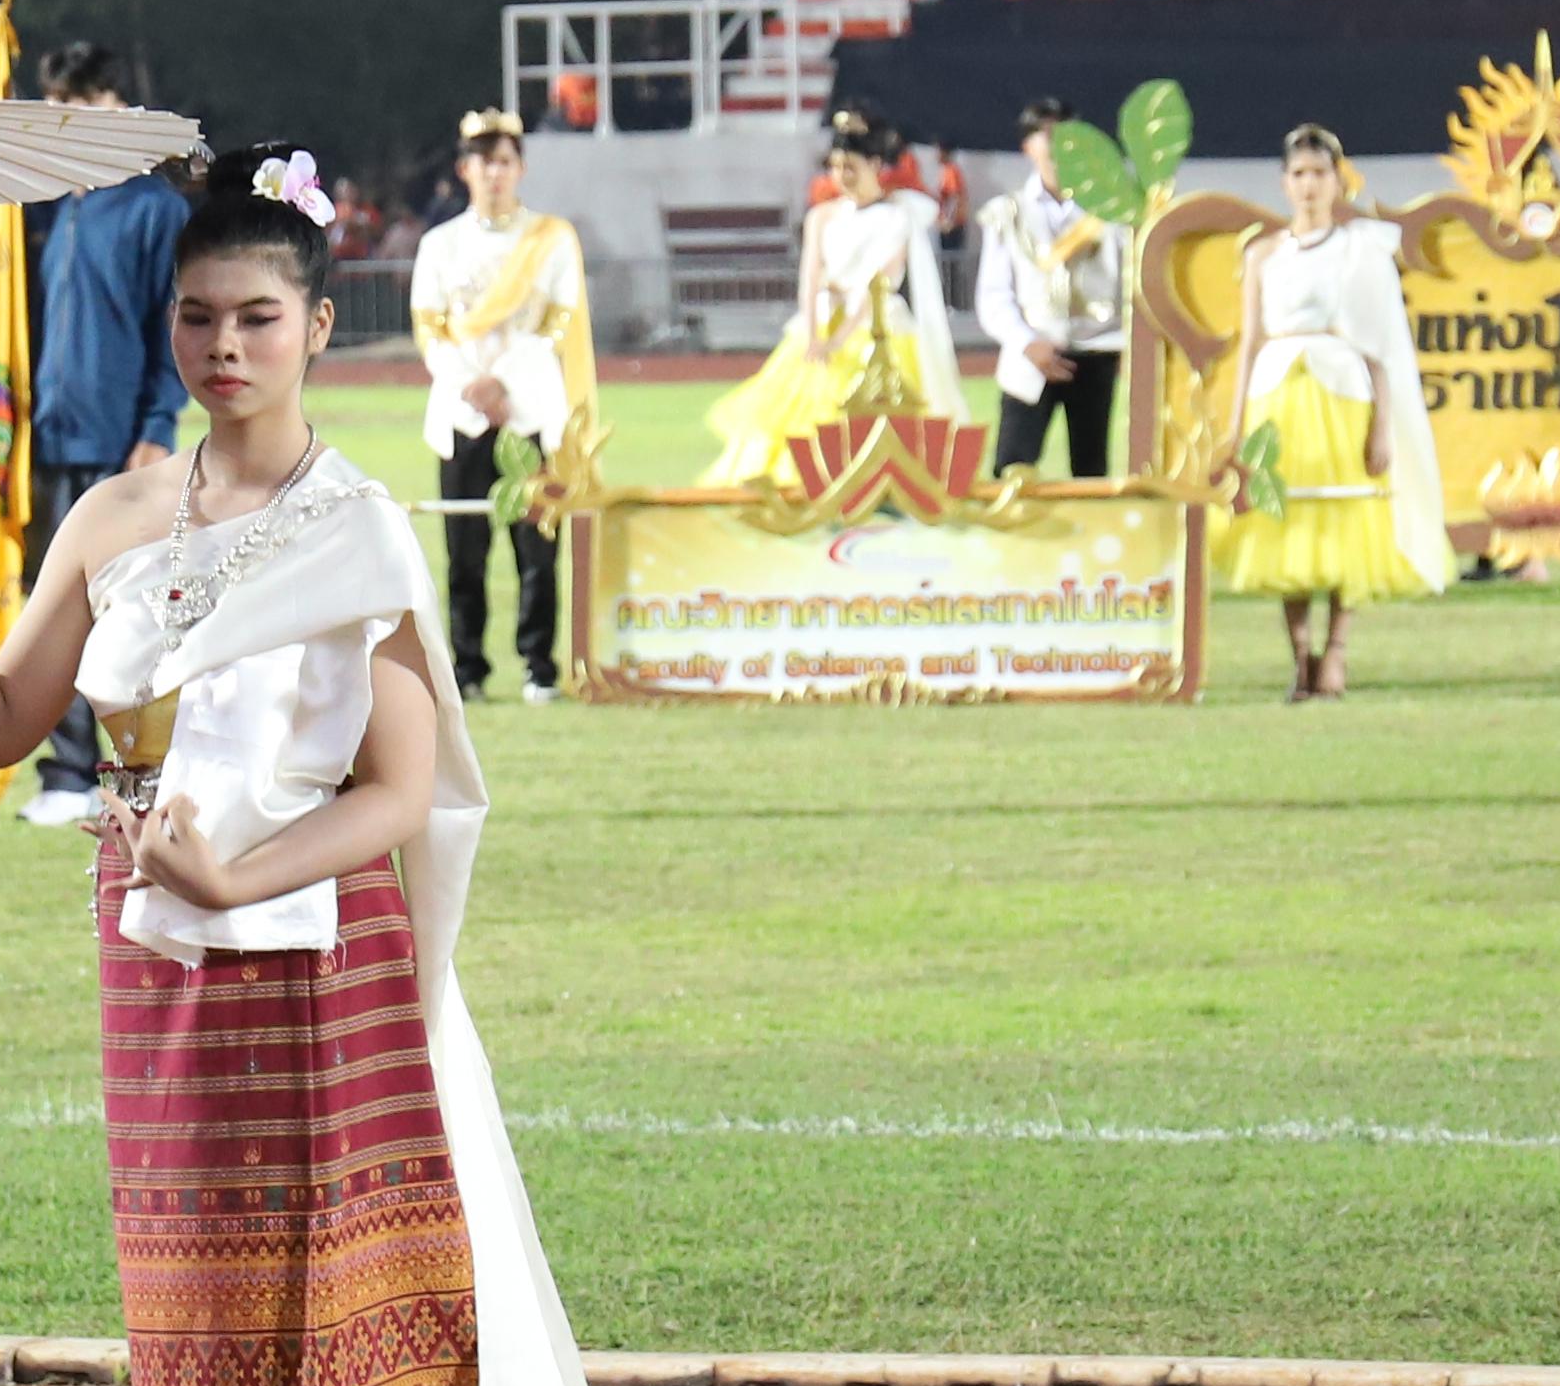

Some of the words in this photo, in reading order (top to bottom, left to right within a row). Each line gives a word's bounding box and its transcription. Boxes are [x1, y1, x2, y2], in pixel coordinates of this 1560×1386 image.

[618, 578, 1174, 629] คณะวิทยาศาสตร์และเทคโนโลยี
[742, 651, 772, 677] of
[785, 649, 906, 678] Science
[921, 647, 976, 675] and
